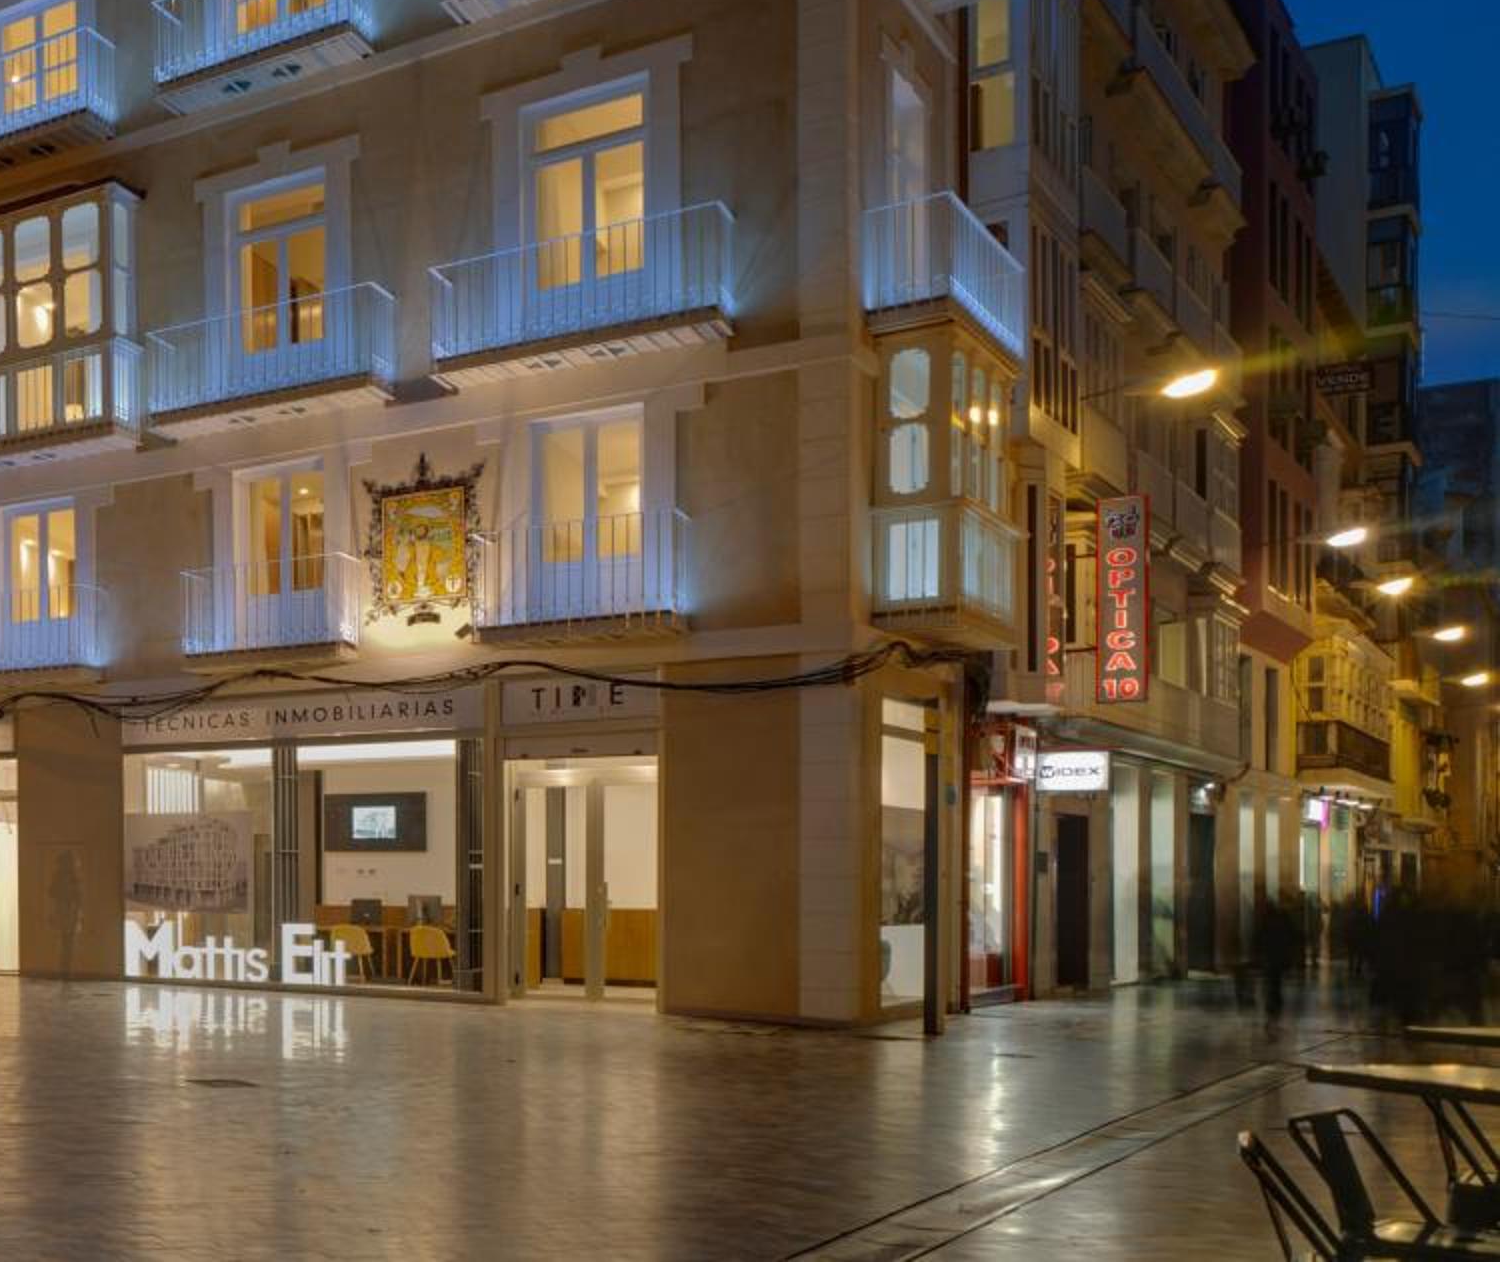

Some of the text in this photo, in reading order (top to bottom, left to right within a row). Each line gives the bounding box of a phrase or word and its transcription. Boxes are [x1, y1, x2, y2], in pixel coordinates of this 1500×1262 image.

[1105, 547, 1137, 671] OPTICA
[1104, 676, 1139, 699] 10
[266, 698, 454, 725] INMOBILIARIAS
[1039, 765, 1100, 779] WIDEX
